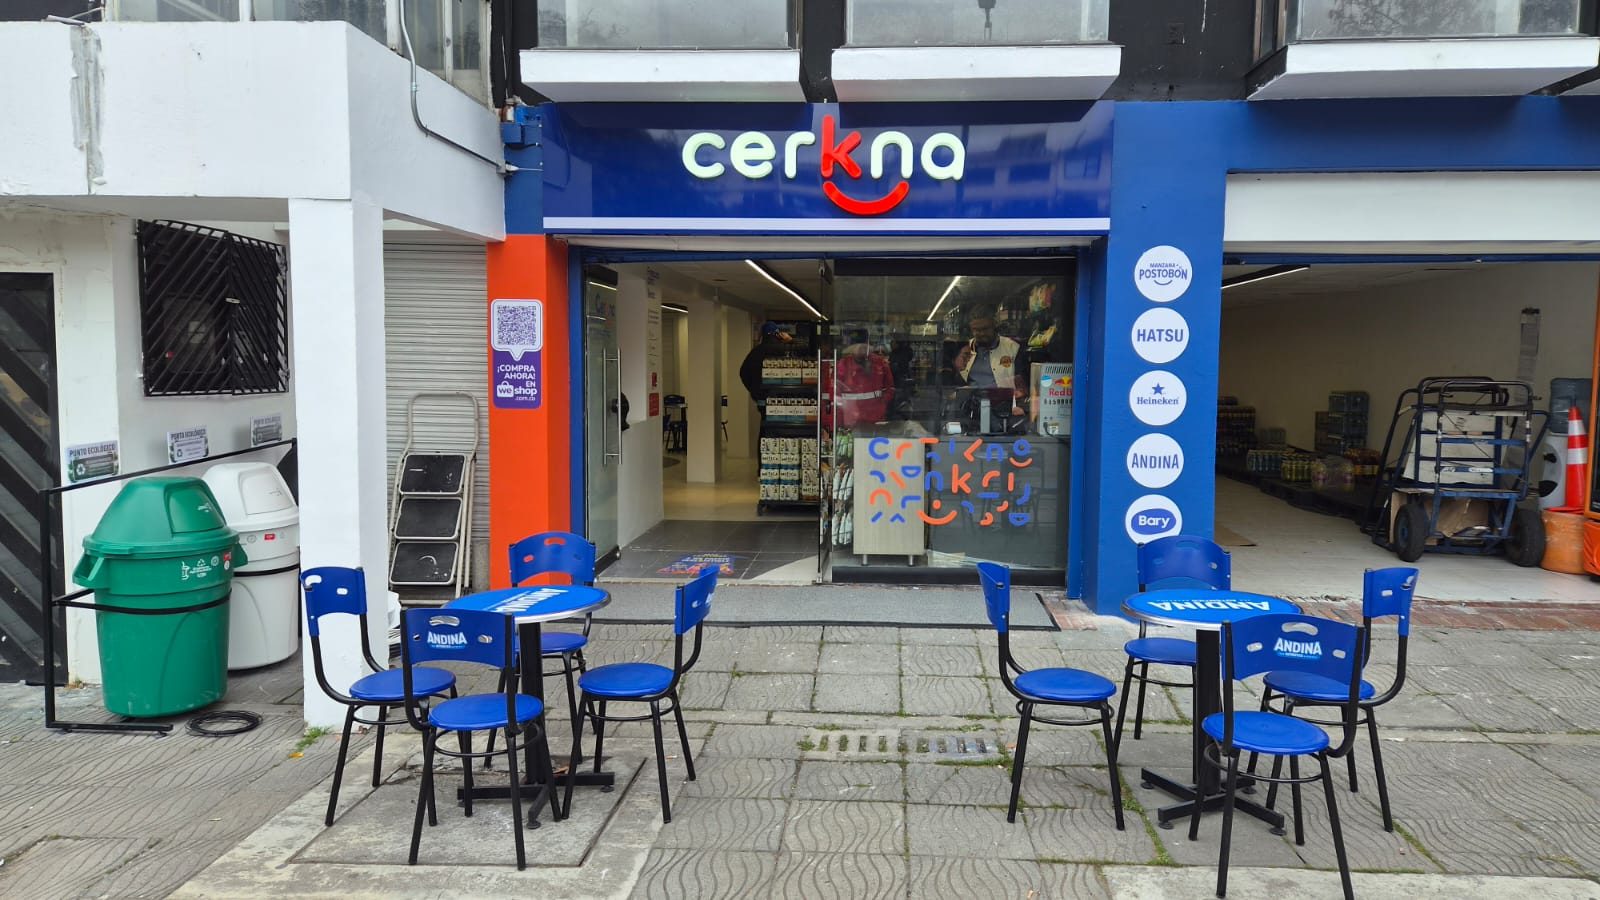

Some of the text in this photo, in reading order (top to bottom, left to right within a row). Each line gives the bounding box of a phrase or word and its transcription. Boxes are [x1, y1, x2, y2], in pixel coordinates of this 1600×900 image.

[682, 115, 966, 181] cerkna
[1137, 328, 1184, 342] HATSU
[497, 364, 536, 373] ¡COMPRA
[525, 380, 536, 388] EN
[1136, 397, 1179, 405] Heineken
[69, 447, 87, 457] PUNTO
[1131, 453, 1179, 469] ANDINA
[1138, 515, 1170, 528] Bary
[1147, 600, 1270, 611] ANDINA
[427, 631, 468, 645] ANDINA
[1273, 637, 1323, 656] ANDINA
